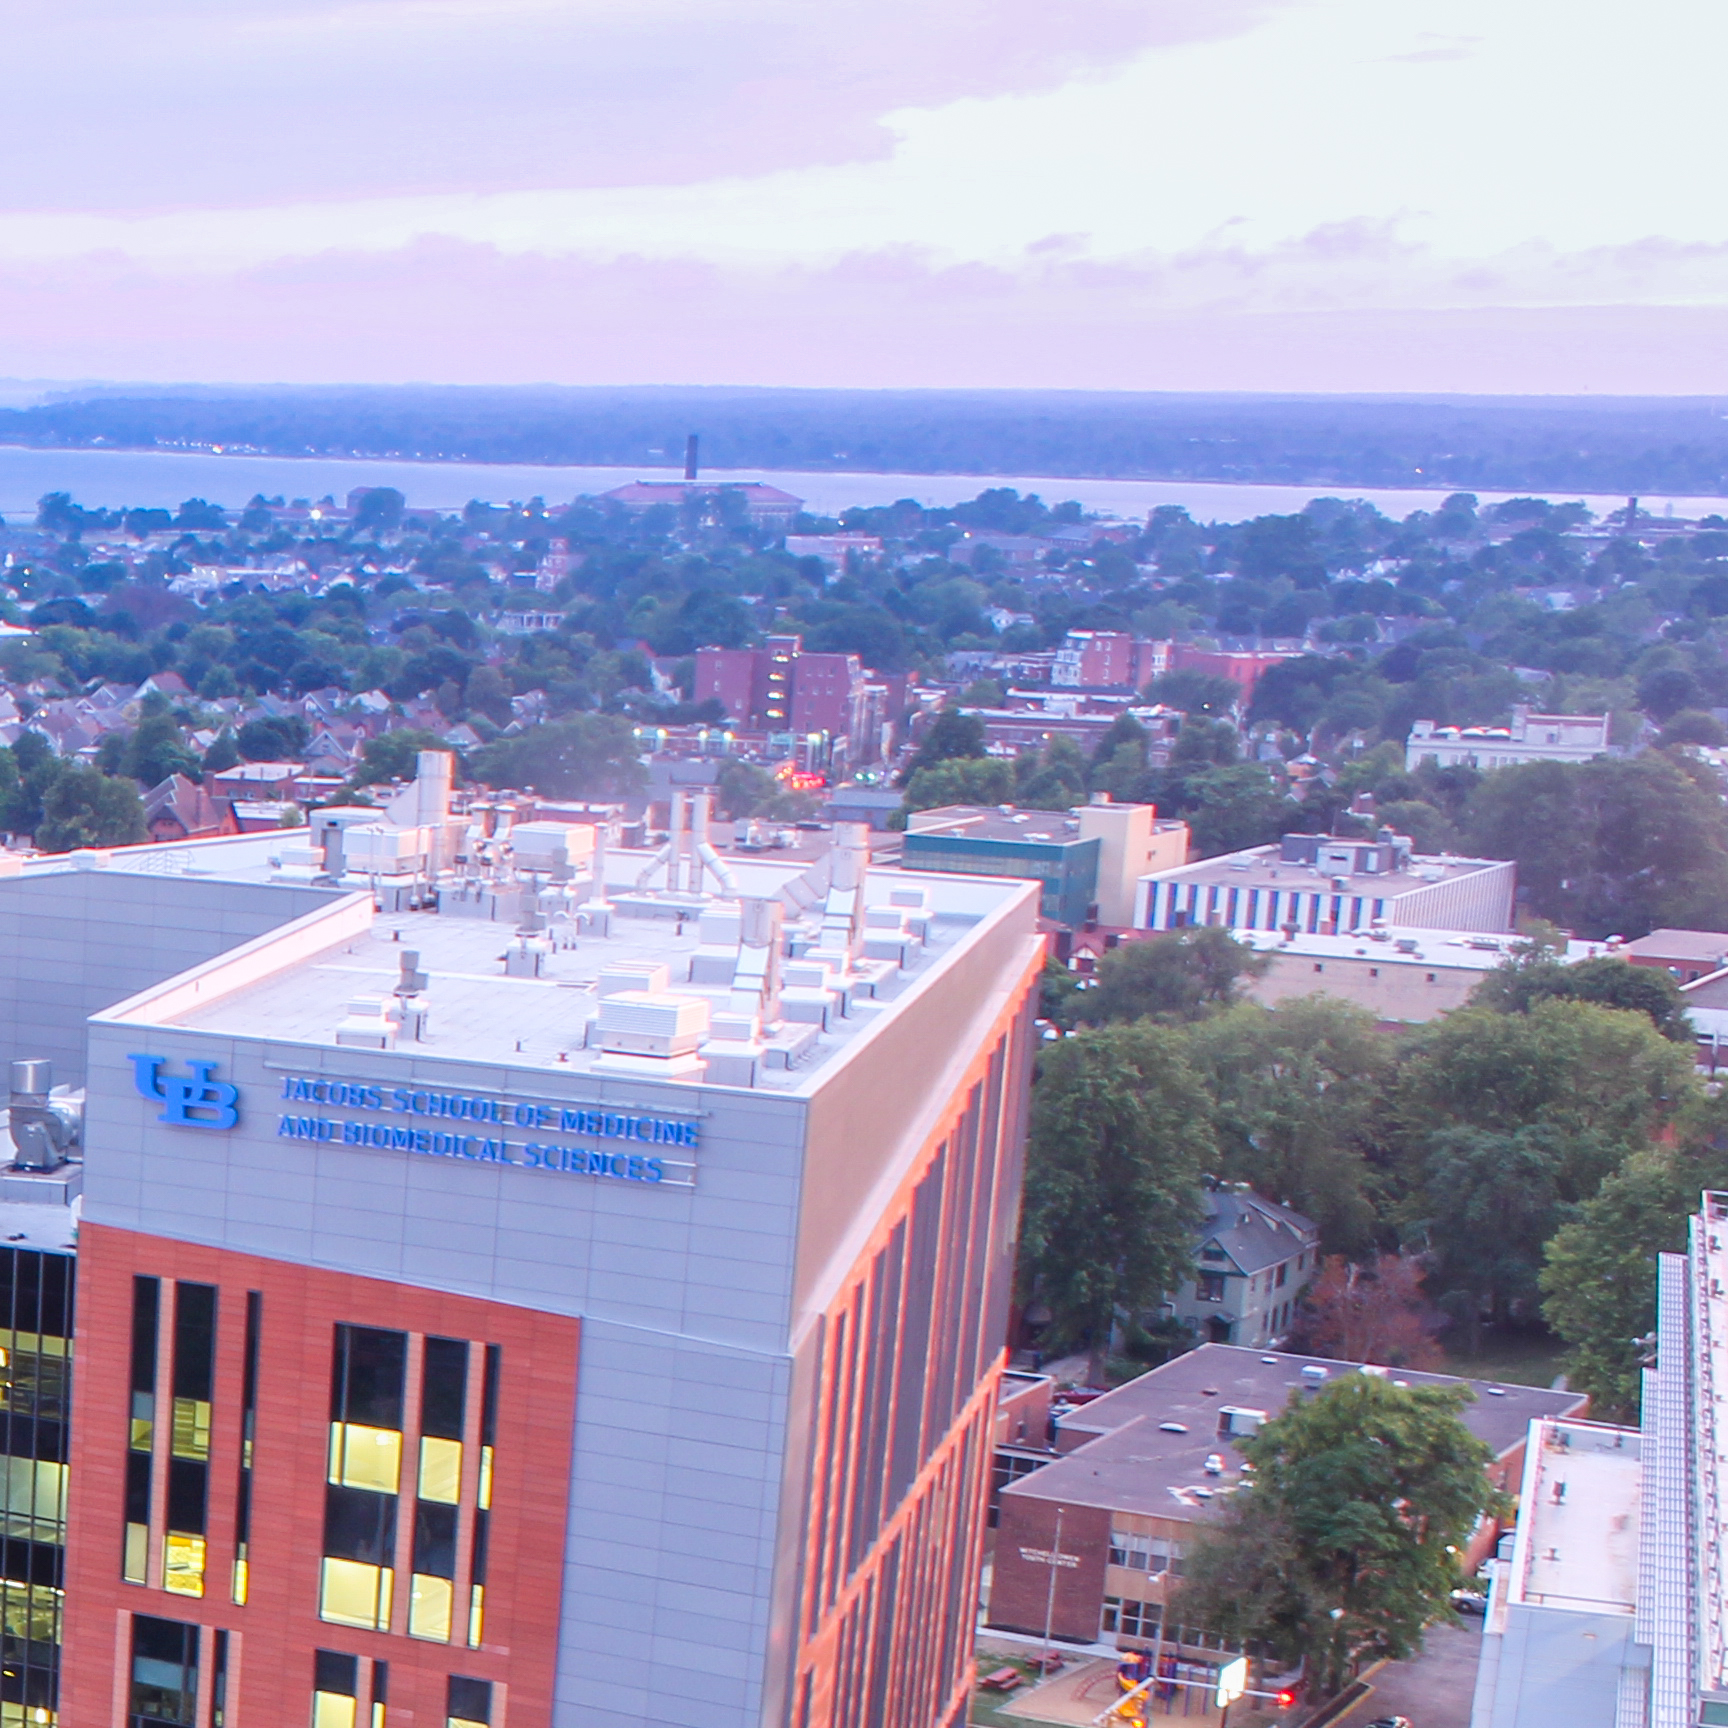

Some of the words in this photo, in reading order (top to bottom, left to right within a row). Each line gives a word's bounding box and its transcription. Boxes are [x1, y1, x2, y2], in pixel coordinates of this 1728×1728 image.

[127, 1053, 239, 1130] UB
[281, 1077, 382, 1110] JACOBS
[392, 1088, 503, 1125] SCHOOL
[514, 1102, 551, 1129] OF
[559, 1108, 698, 1147] MEDICINE
[279, 1114, 332, 1142] AND
[343, 1121, 512, 1165] BIOMEDICAL
[523, 1142, 662, 1183] SCIENCES
